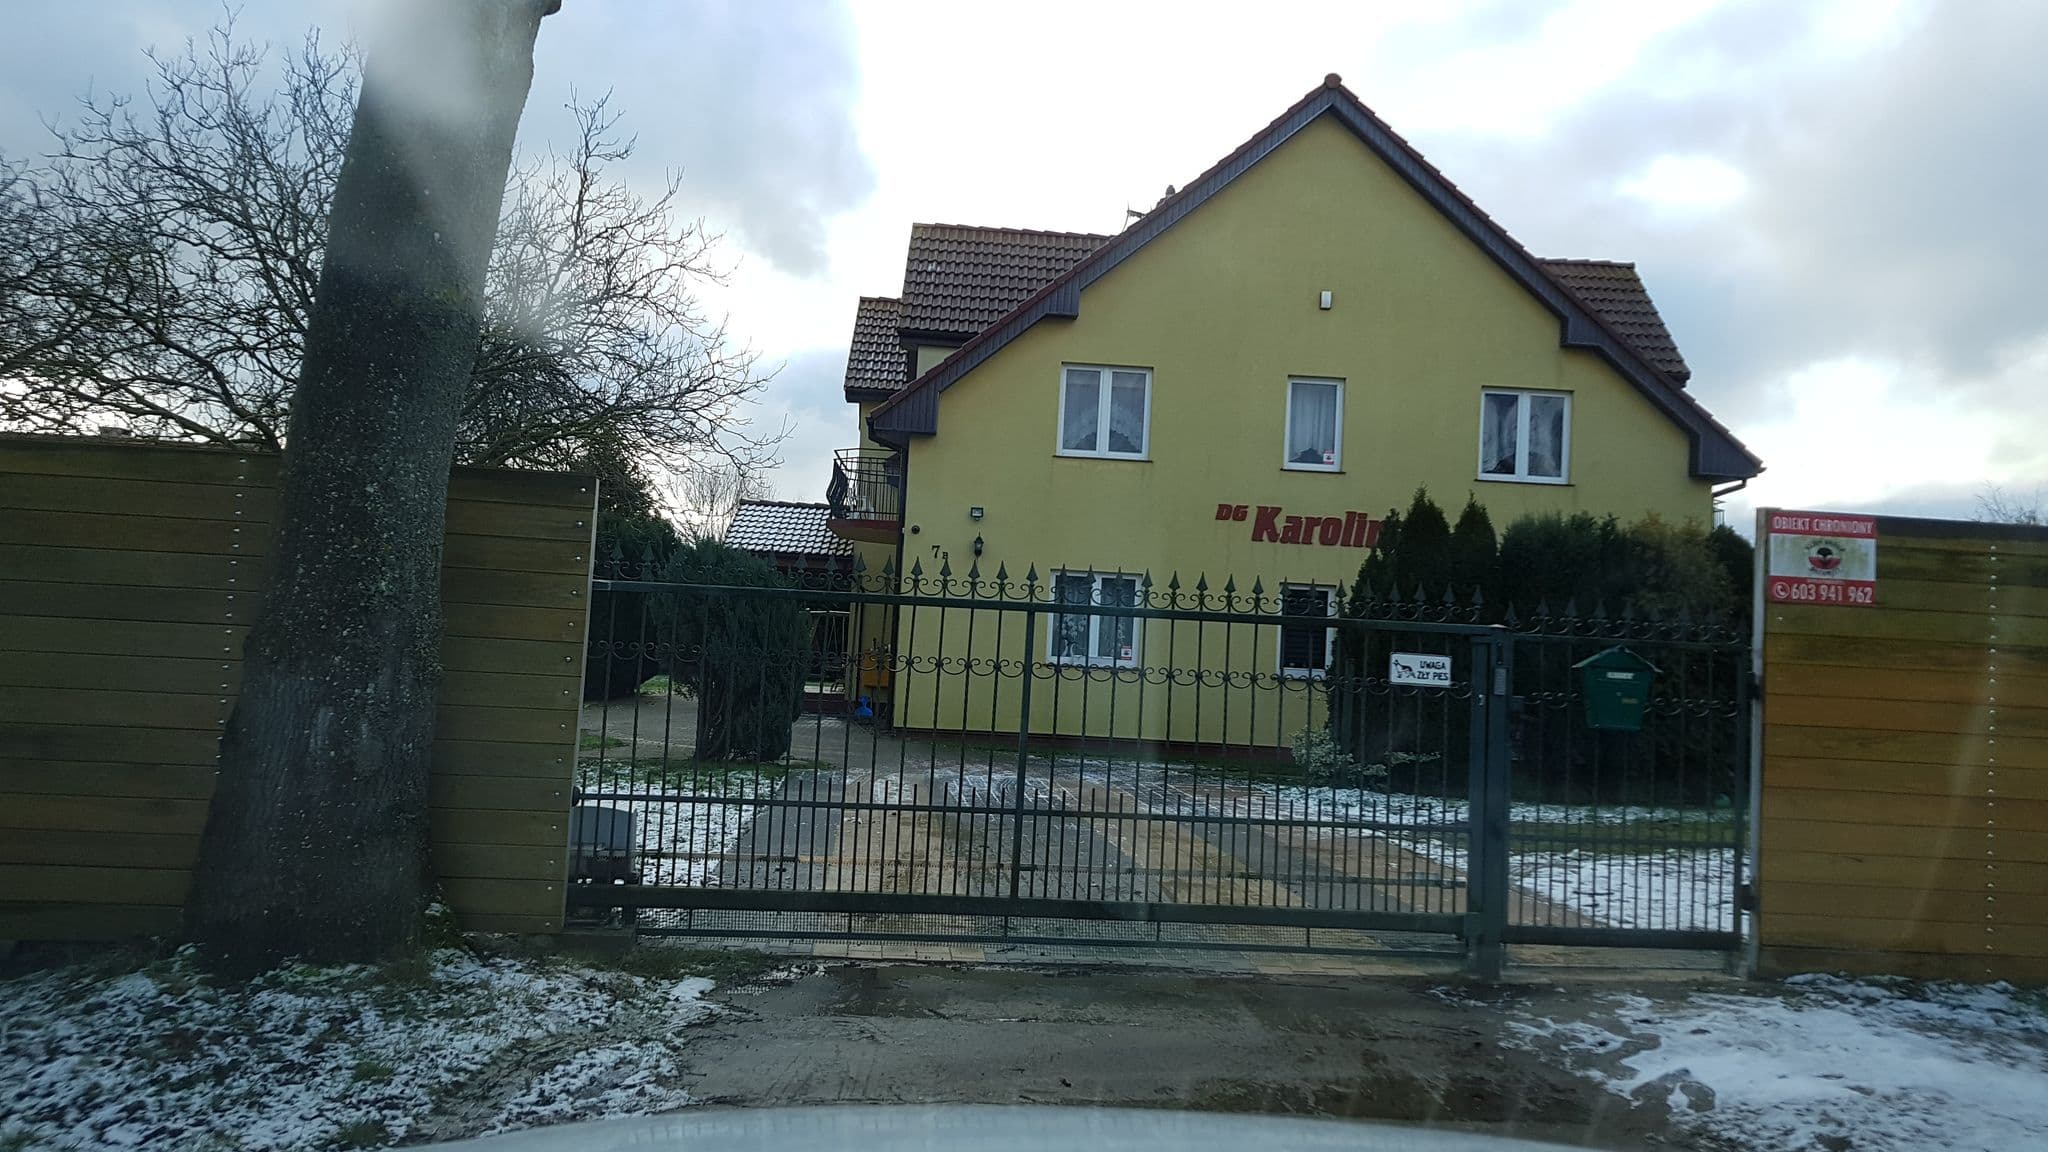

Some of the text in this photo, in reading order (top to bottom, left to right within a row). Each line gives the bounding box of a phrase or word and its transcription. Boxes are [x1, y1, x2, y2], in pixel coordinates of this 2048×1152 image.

[1215, 504, 1249, 521] DG
[1773, 516, 1810, 530] OBIEKT
[1791, 584, 1873, 603] 603 941 962
[1420, 660, 1447, 671] UWAGA
[1432, 672, 1449, 681] PIES
